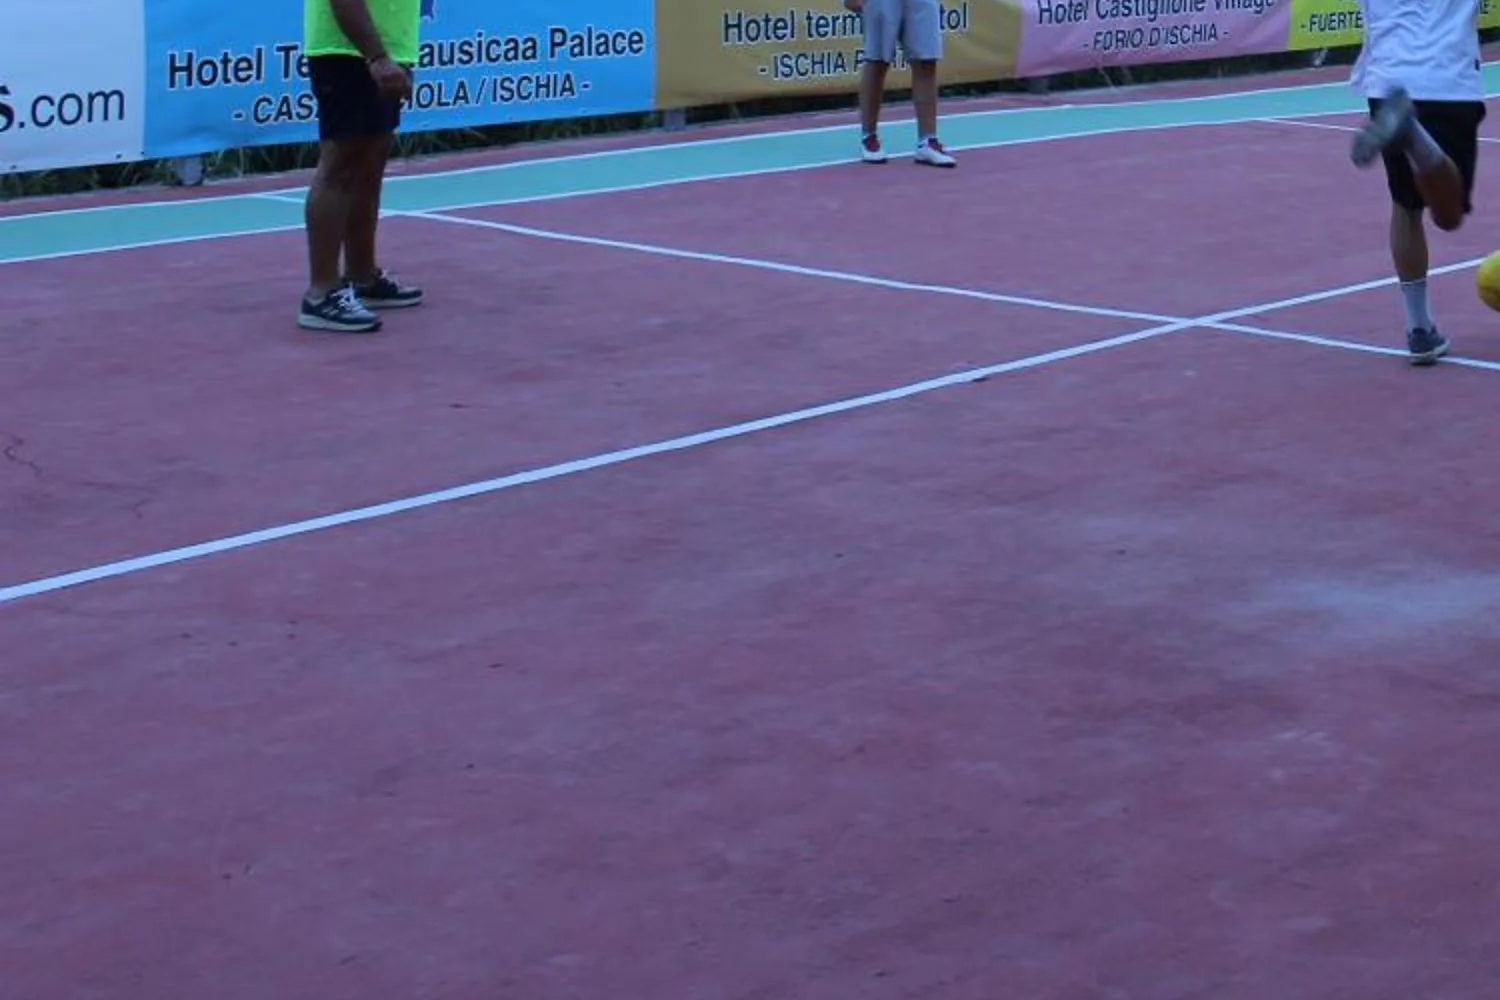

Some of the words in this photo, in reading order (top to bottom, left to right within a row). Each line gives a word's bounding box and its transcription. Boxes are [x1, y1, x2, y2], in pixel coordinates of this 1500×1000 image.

[722, 10, 796, 43] Hotel
[805, 9, 864, 38] term
[1309, 10, 1364, 32] FUERTE
[1093, 28, 1144, 51] FORIO
[1148, 23, 1218, 47] D'ISCHIA
[168, 46, 263, 89] Hotel
[408, 30, 538, 69] ausicaa
[549, 24, 644, 59] Palace
[773, 49, 847, 79] ISCHIA
[492, 71, 575, 102] ISCHIA
